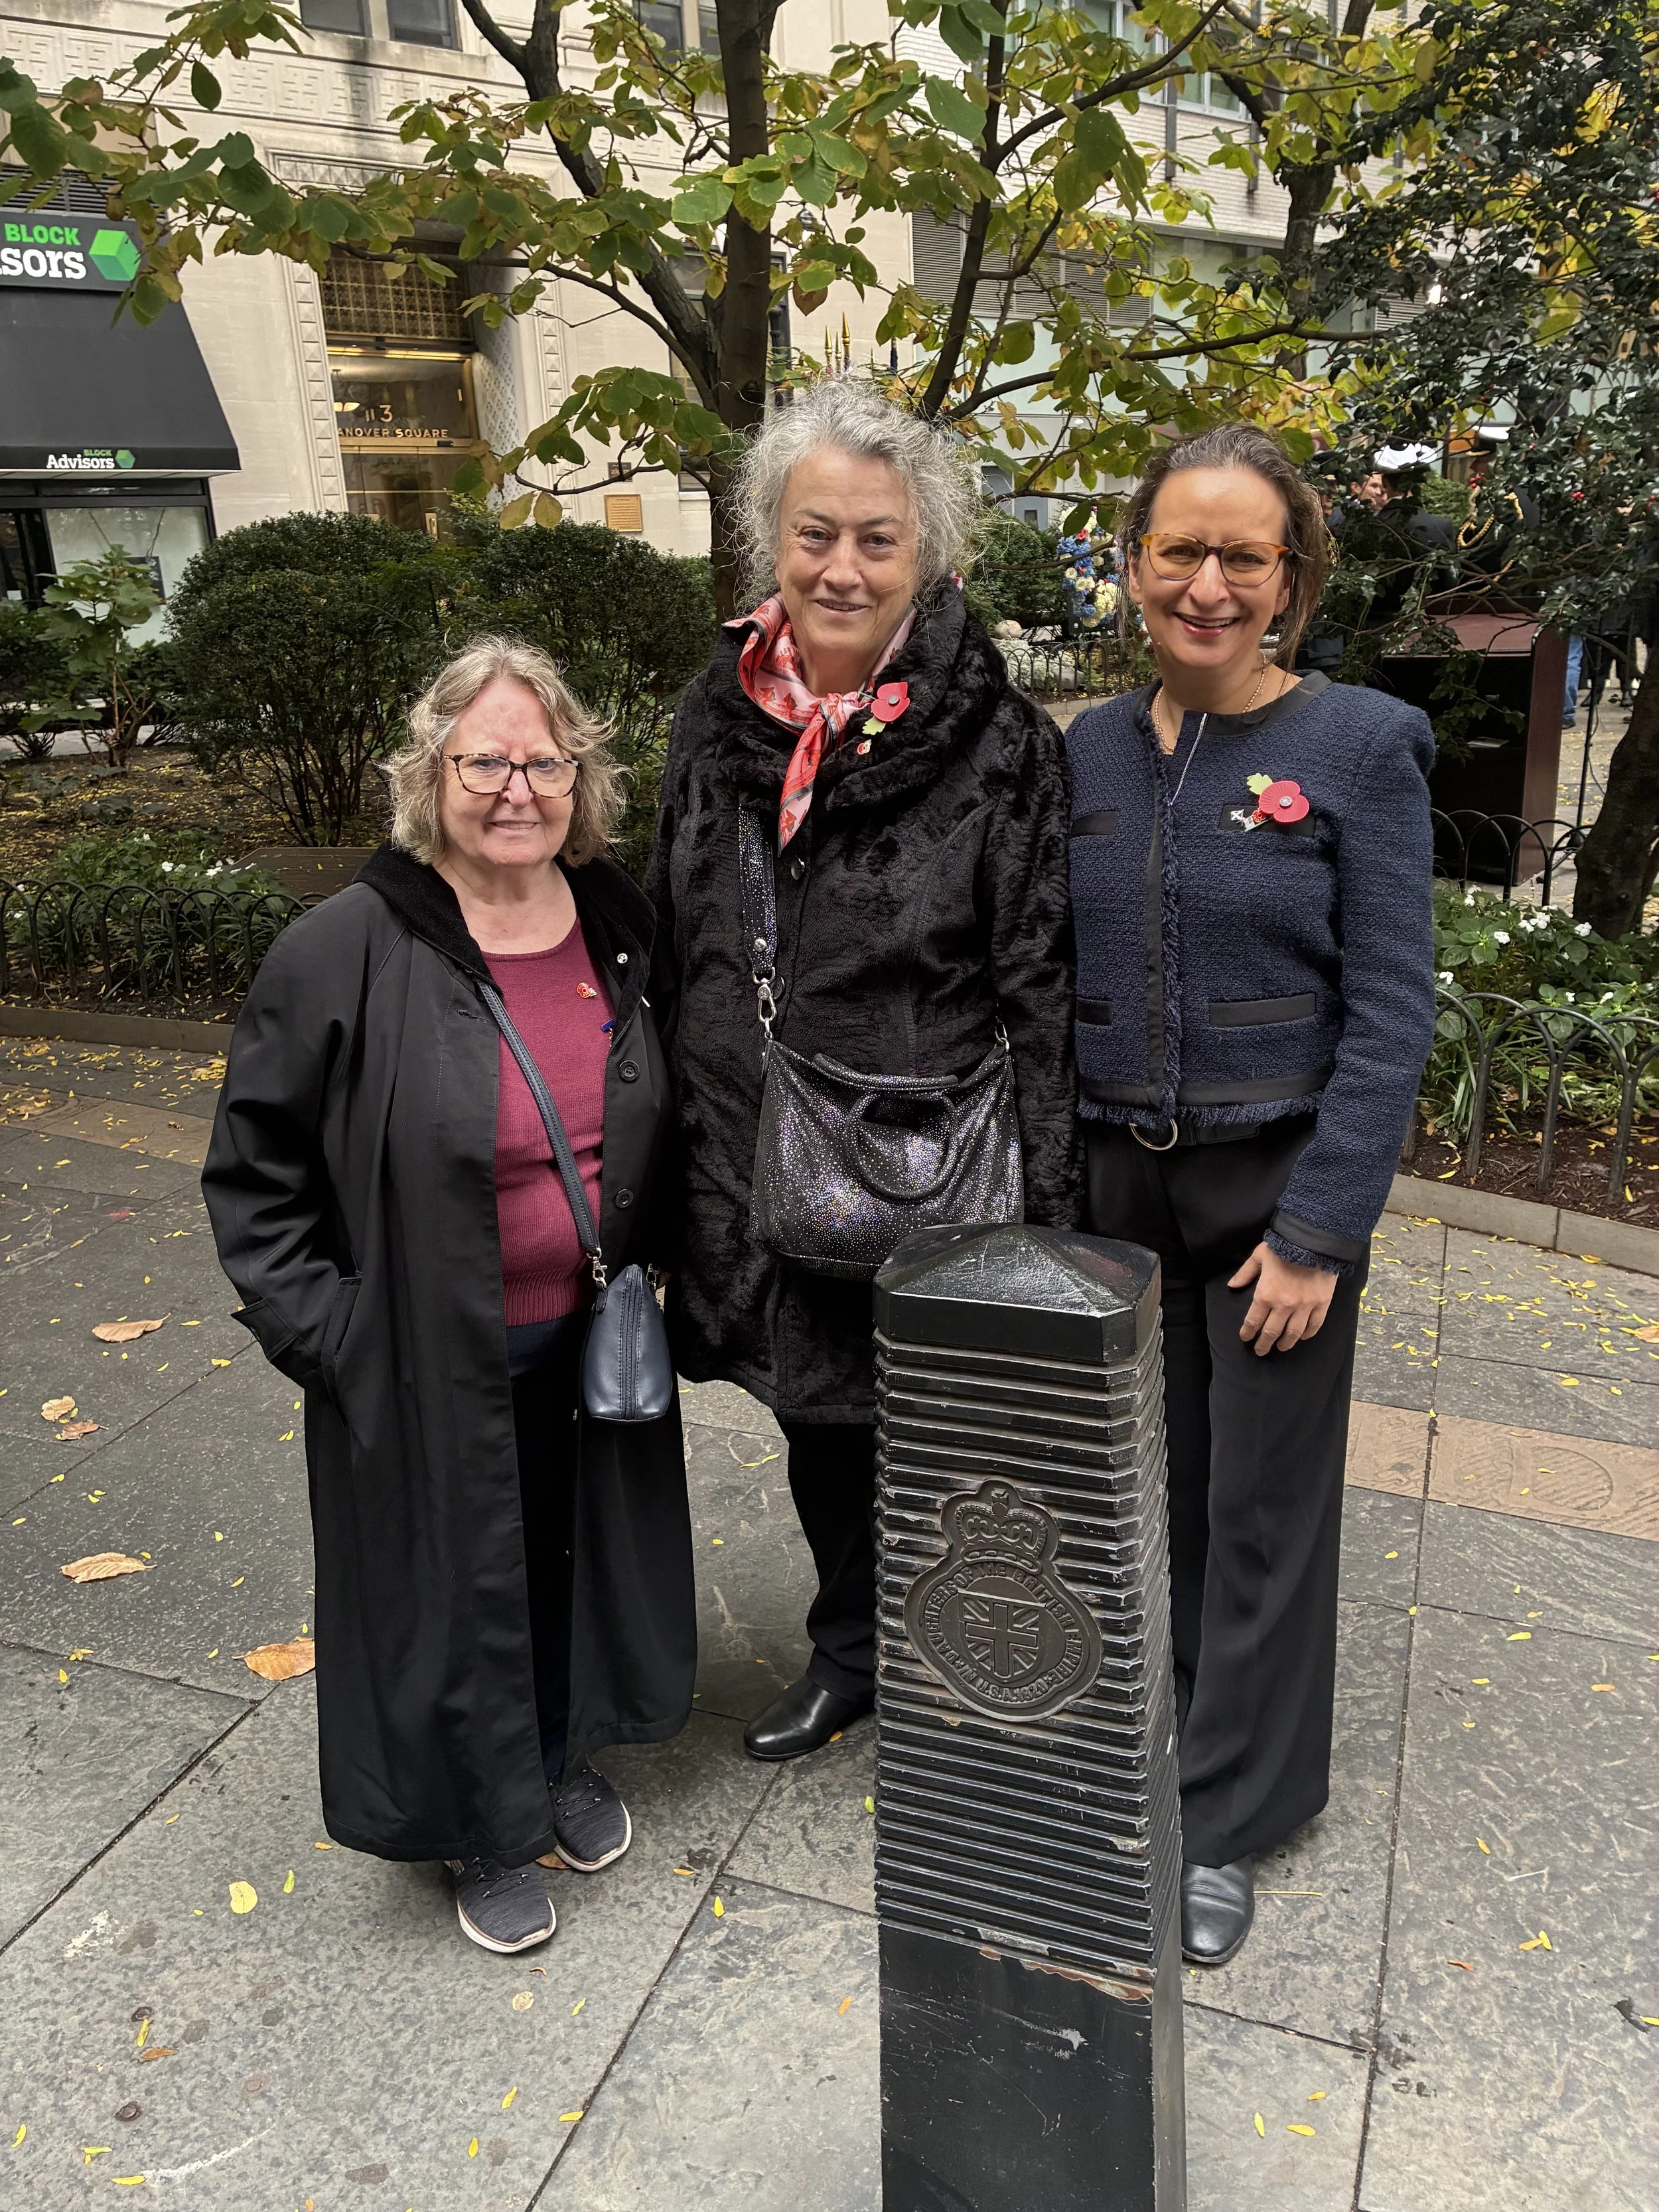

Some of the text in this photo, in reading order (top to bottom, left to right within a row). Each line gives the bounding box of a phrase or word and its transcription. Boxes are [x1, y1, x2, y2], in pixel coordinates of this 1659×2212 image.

[5, 223, 81, 246] BLOCK
[0, 248, 86, 279] sors
[338, 427, 449, 438] ANOVER SQUARE
[46, 454, 115, 469] Advisors
[924, 1562, 1083, 1681] DAUGHTERS OF THE BRITISH EMPIRE
